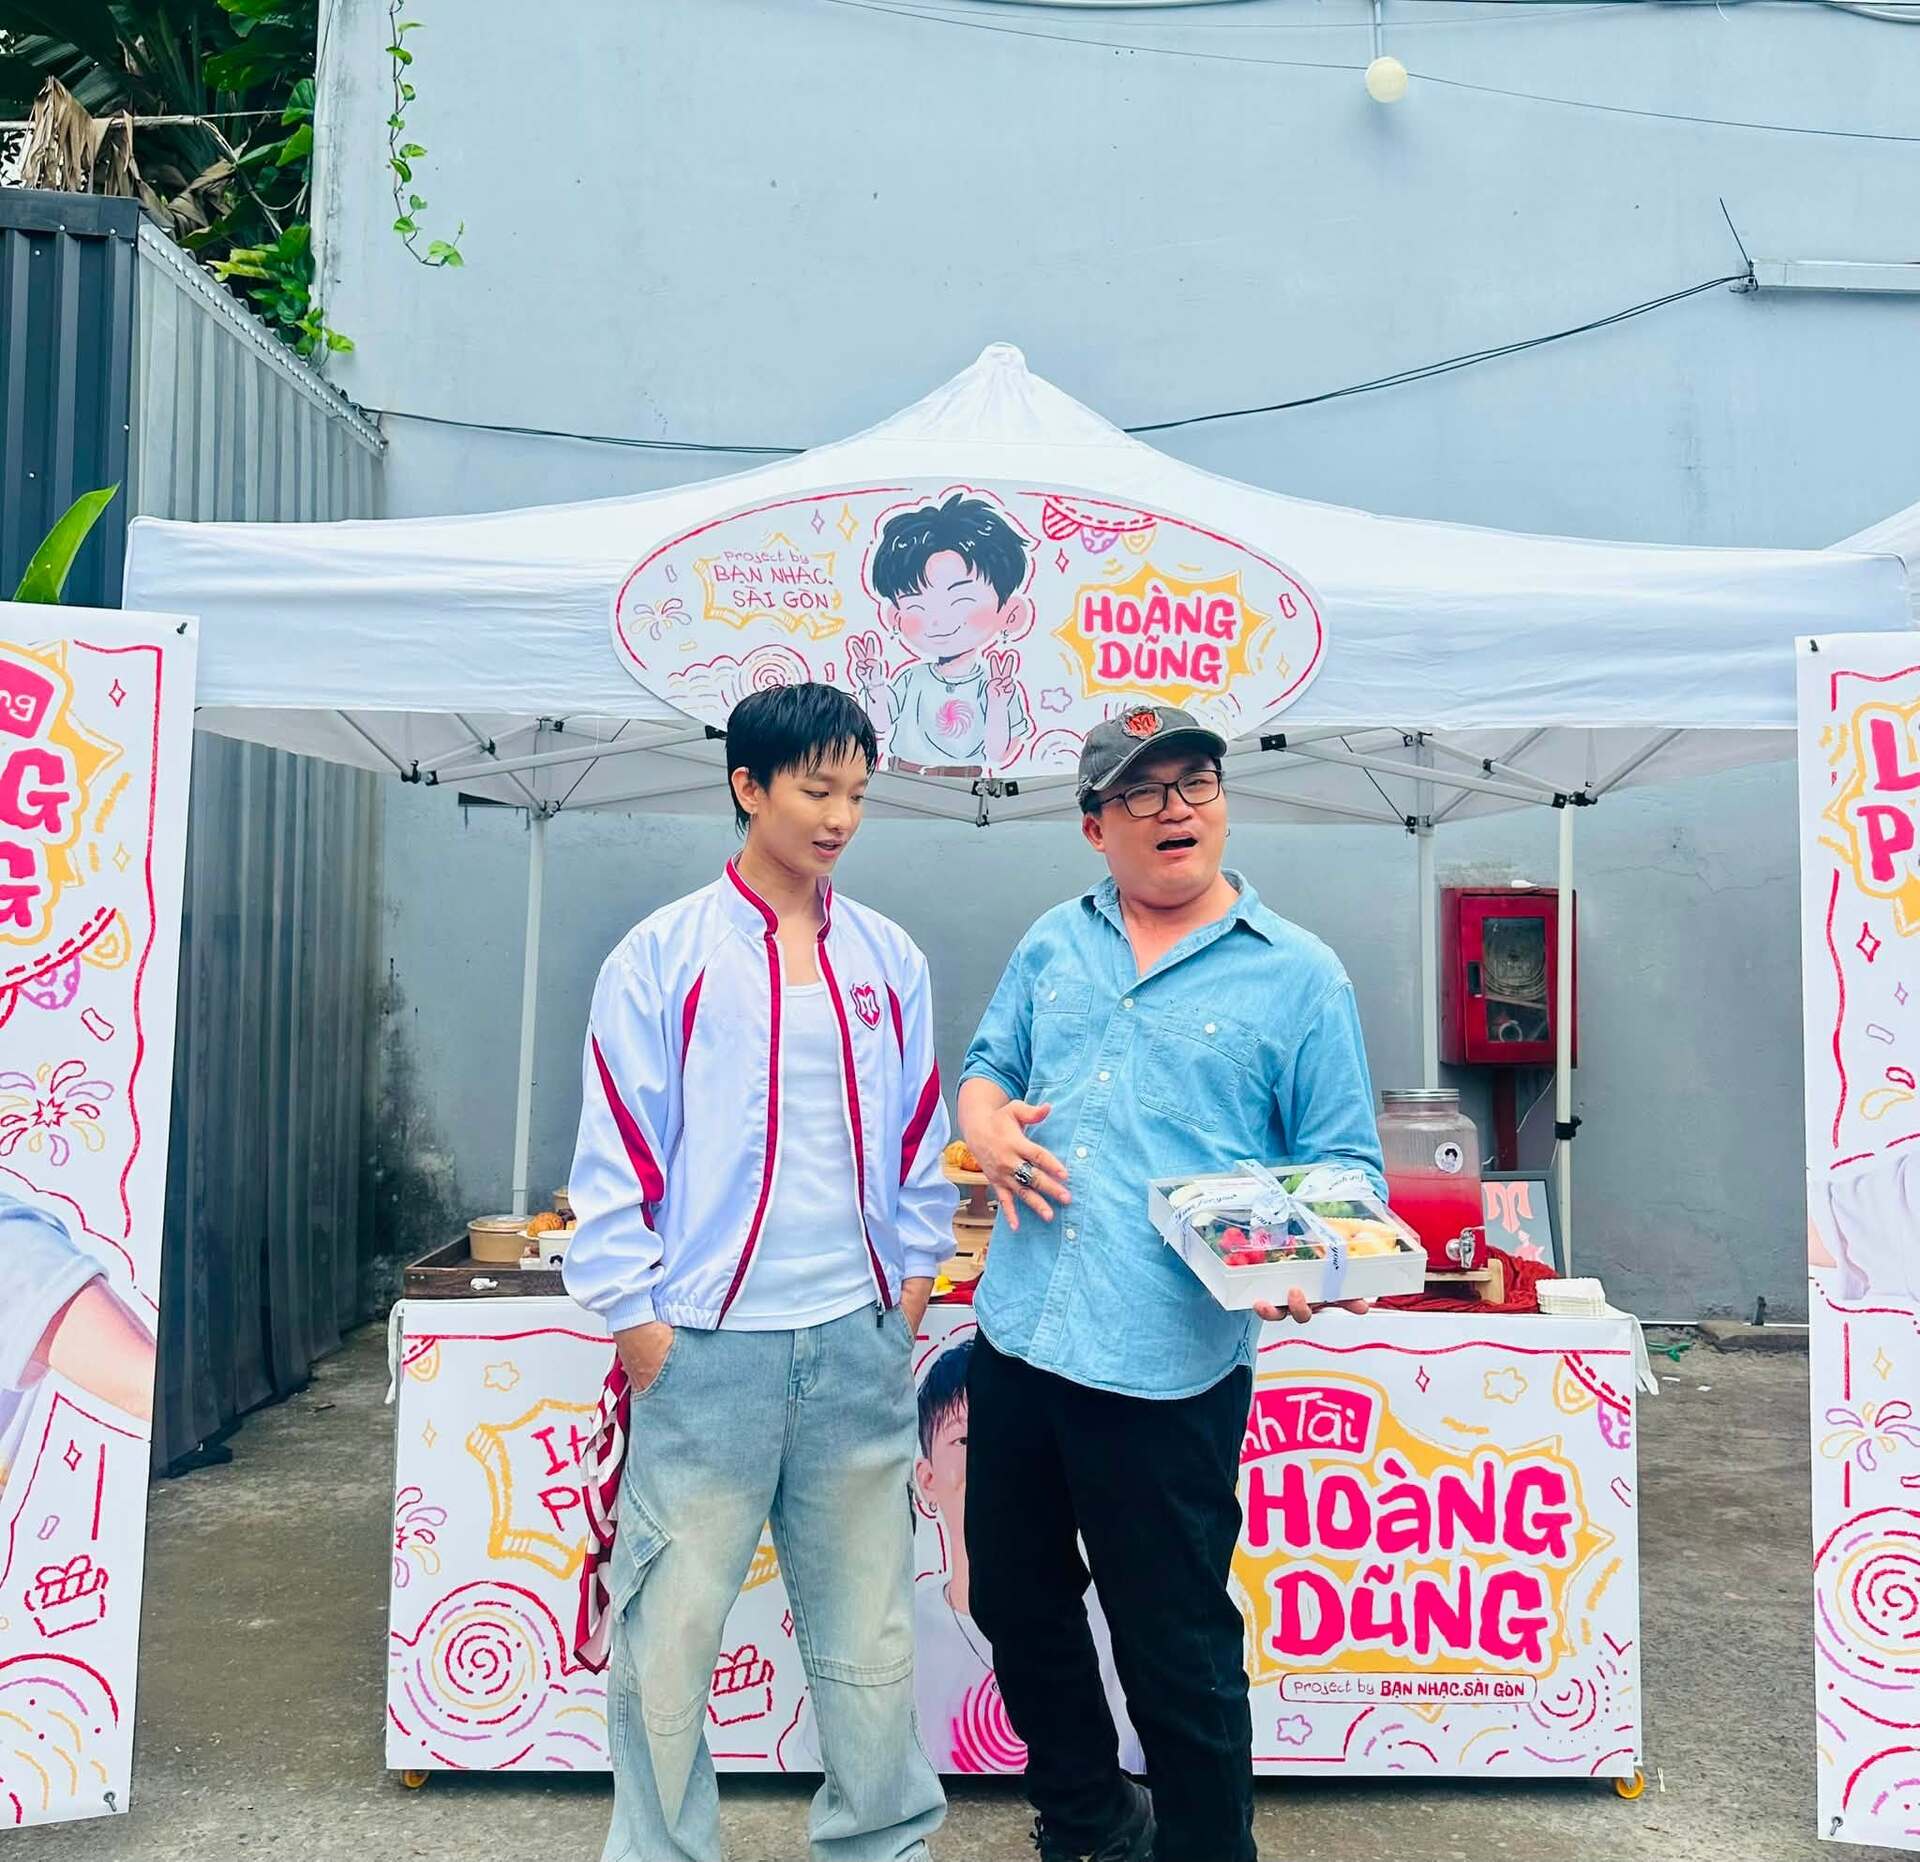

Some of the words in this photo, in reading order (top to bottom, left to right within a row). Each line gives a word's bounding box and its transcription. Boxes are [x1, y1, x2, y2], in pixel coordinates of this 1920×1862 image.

[789, 550, 810, 564] by
[713, 565, 763, 584] BẠN
[732, 585, 776, 608] SÀI
[782, 588, 829, 609] GÒN
[1084, 585, 1237, 640] HOÀNG
[1097, 635, 1222, 685] DŨNG
[1286, 1391, 1359, 1446] Tài
[1358, 1678, 1375, 1695] by
[1380, 1680, 1412, 1699] BẠN
[1493, 1681, 1525, 1698] GÒN
